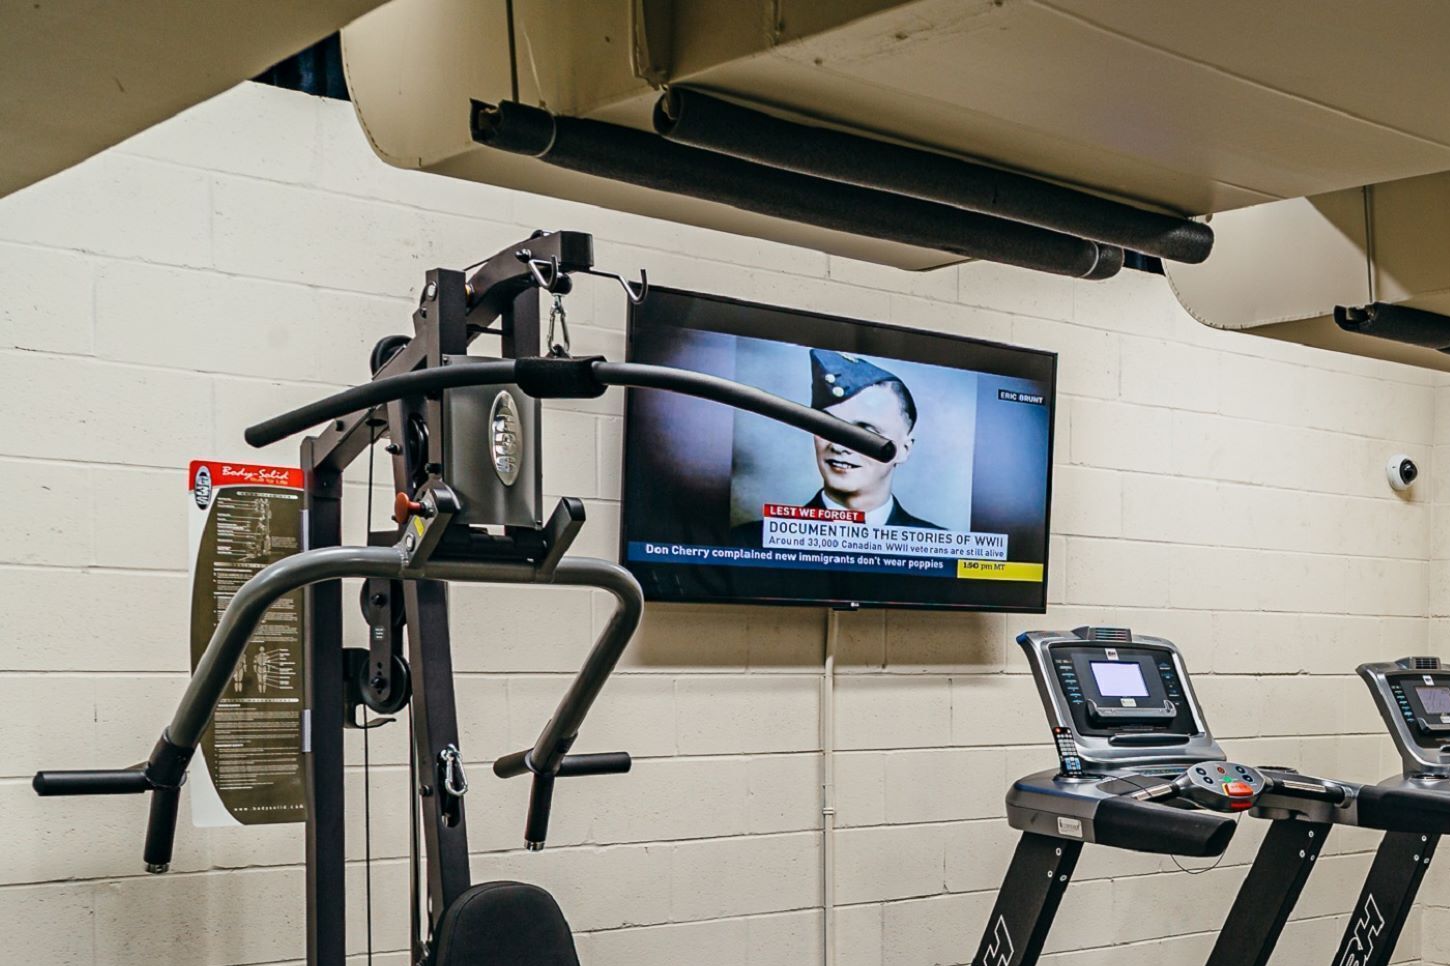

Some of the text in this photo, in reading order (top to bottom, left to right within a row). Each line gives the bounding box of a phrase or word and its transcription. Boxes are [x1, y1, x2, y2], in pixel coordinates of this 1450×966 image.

[1000, 391, 1017, 401] ERIC
[222, 466, 289, 480] Body-Solid
[770, 506, 859, 520] LEST WE FORGET
[769, 521, 1003, 548] DOCUMENTING THE STORIES OF WWII
[769, 536, 1004, 558] Around 33,000 Canadian WWII veterans are still alive
[645, 544, 944, 571] Don Cherry complained new immigrants don't wear poppies
